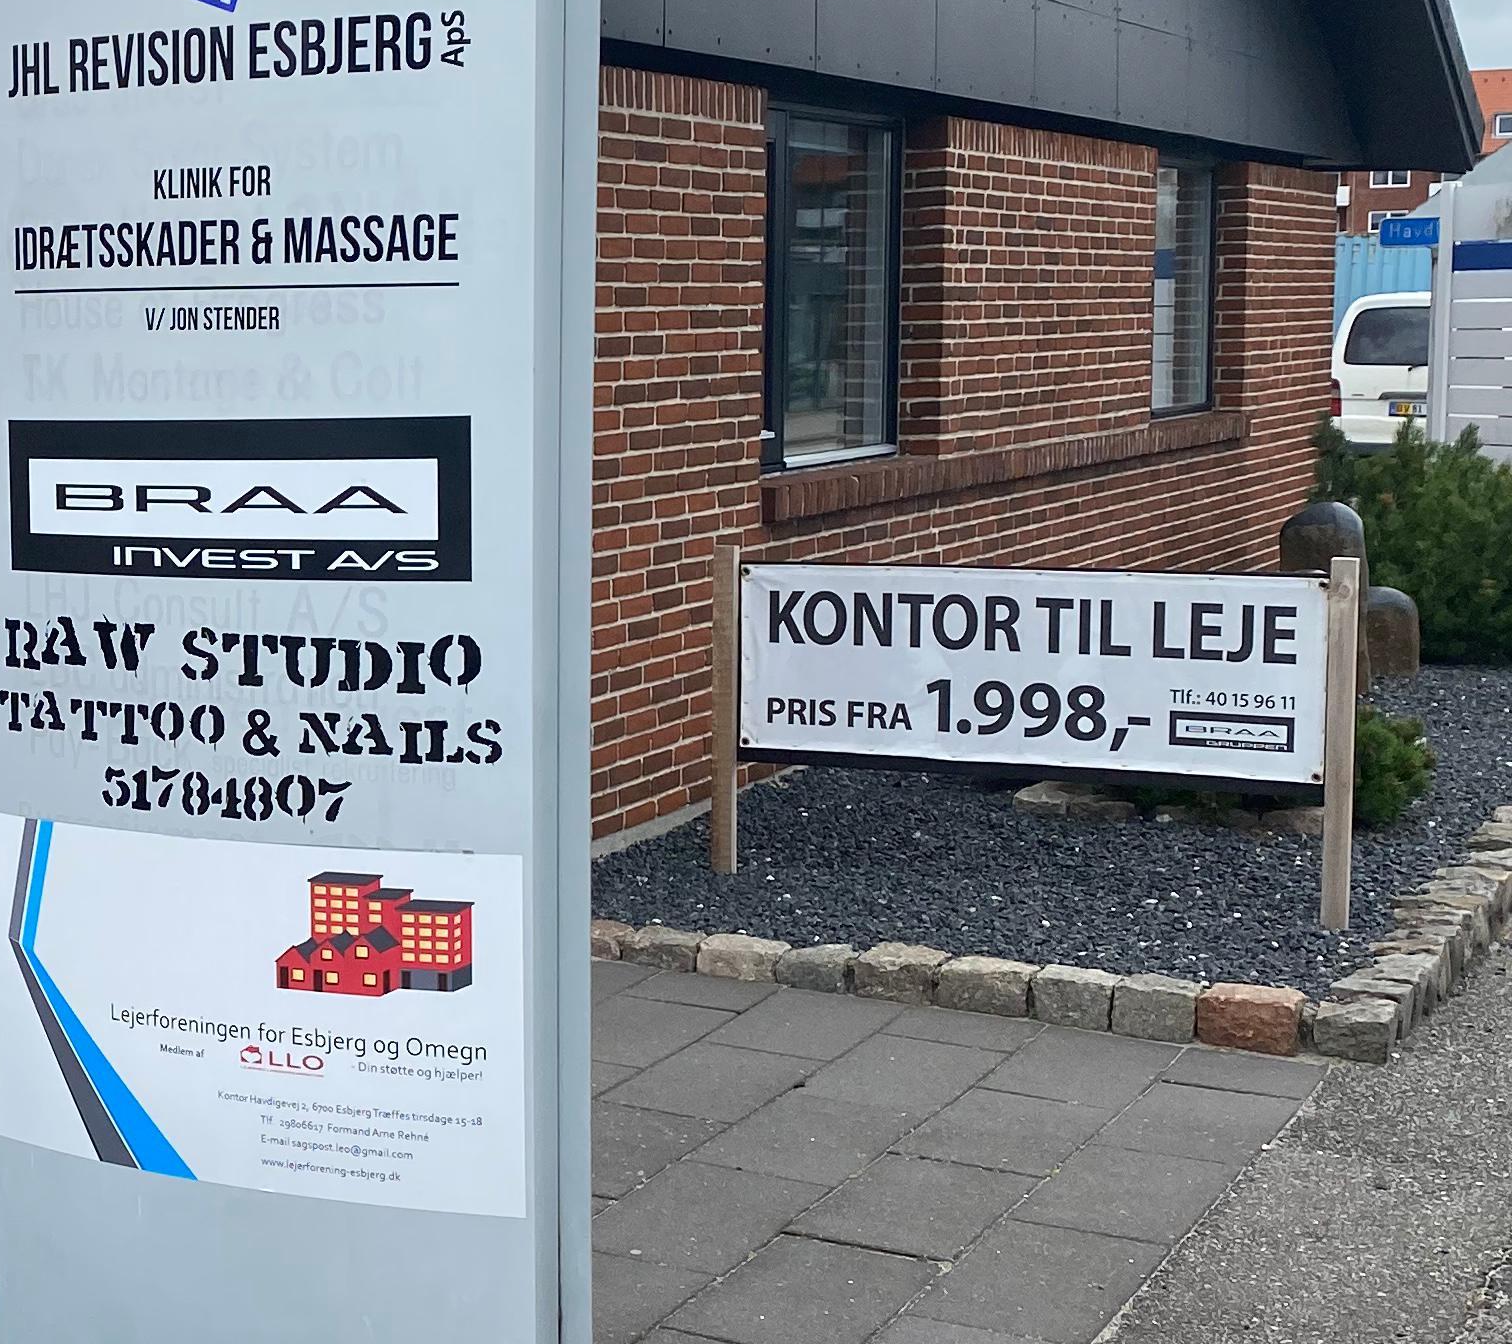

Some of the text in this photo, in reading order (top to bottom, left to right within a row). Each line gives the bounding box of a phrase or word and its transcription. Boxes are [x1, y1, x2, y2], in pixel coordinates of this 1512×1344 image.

[8, 9, 471, 98] JHL REVISION ESBJERG ApS
[153, 165, 271, 200] KLINIK FOR
[14, 213, 459, 271] IDRÆTSSKADER & MASSAGE
[145, 305, 280, 331] V/ JON STENDER
[55, 483, 409, 515] BRAA
[113, 545, 440, 571] INVEST A/S
[768, 590, 1298, 665] KONTOR TIL LEJE
[4, 613, 156, 675] RAW
[180, 625, 482, 696] STUDIO
[767, 678, 1151, 752] PRIS FRA 1.998,-
[1169, 689, 1296, 711] Tlf.: 40 15 96 11
[0, 690, 225, 751] TATTOO
[241, 708, 281, 758] &
[298, 711, 503, 766] NAILS
[1185, 725, 1281, 738] BRAA
[101, 765, 353, 825] 51784807
[111, 1002, 487, 1066] Lejerforeningen for Esbjerg og Omegn
[159, 1043, 205, 1058] Medlem af
[269, 1050, 325, 1071] LLO
[357, 1061, 378, 1073] Din
[380, 1064, 414, 1076] støtte
[416, 1068, 432, 1080] og
[434, 1067, 483, 1083] hjælper!
[217, 1089, 249, 1103] Kontor
[249, 1095, 300, 1112] Havdigevej
[311, 1102, 334, 1115] 6700
[336, 1104, 372, 1120] Esbjerg
[411, 1112, 453, 1126] tirsdage
[327, 1122, 371, 1137] Formand
